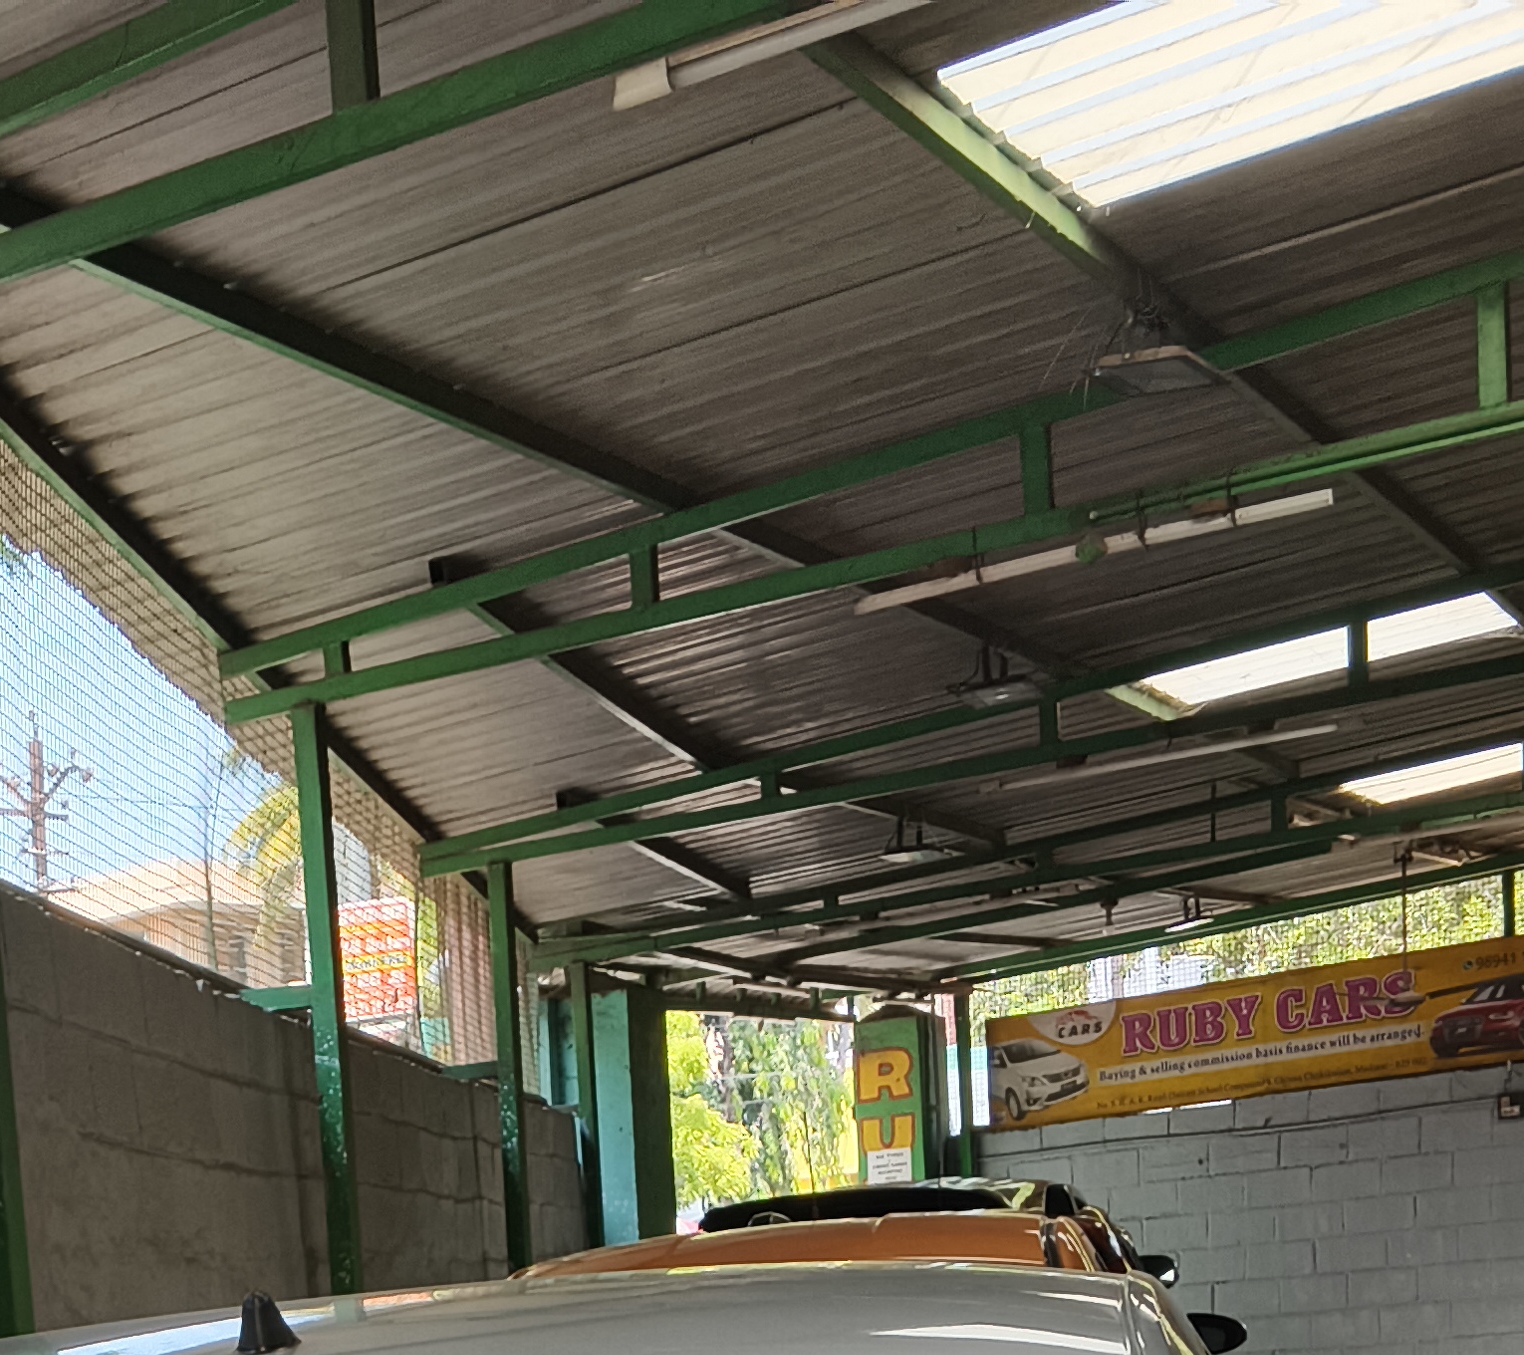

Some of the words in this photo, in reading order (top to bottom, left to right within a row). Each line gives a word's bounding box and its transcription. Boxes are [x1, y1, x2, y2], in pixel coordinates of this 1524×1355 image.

[1057, 1021, 1103, 1039] CARS
[1119, 992, 1261, 1057] RUBY
[1274, 969, 1418, 1033] CARS
[1150, 1060, 1186, 1074] selling
[1187, 1051, 1253, 1069] commission
[1255, 1045, 1284, 1059] basis
[1286, 1041, 1326, 1055] finance
[1328, 1033, 1351, 1048] will
[1353, 1033, 1367, 1045] be
